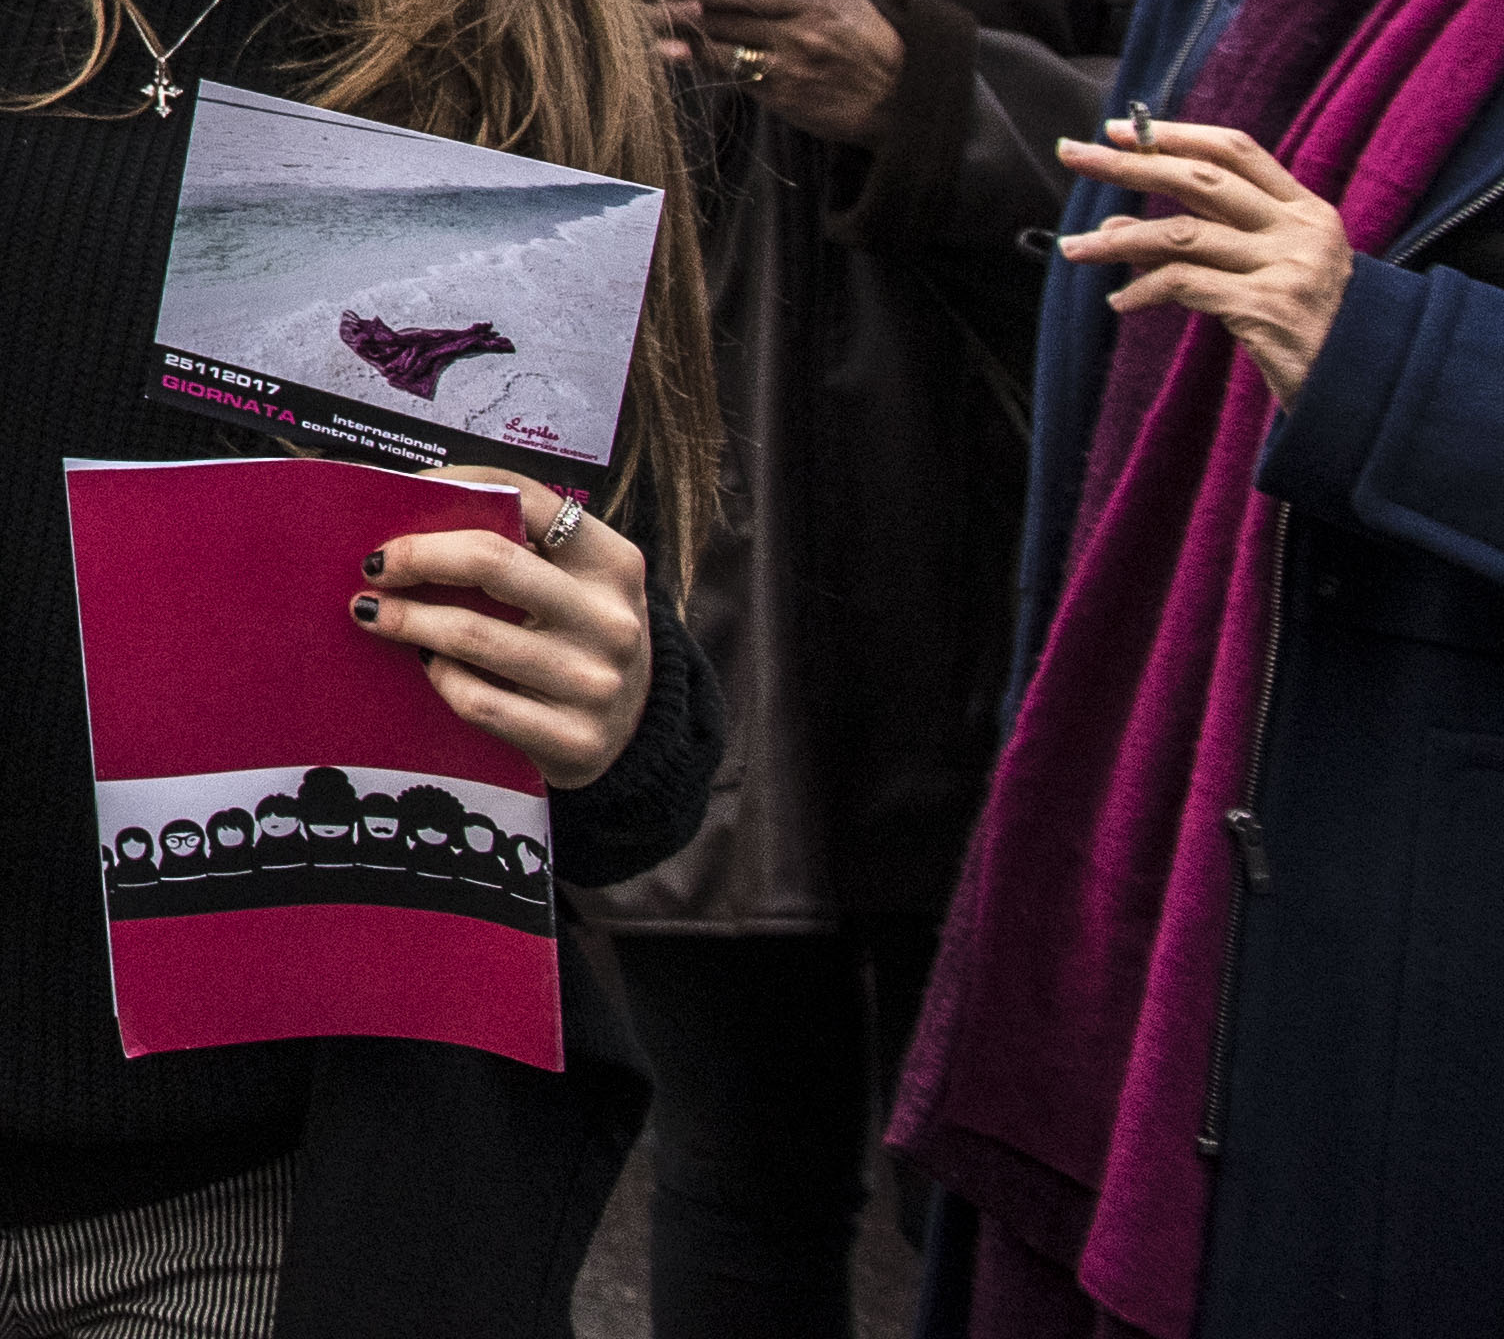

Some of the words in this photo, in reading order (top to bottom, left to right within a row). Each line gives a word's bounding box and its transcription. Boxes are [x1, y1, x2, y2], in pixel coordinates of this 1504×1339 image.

[165, 352, 281, 396] 25112017
[161, 374, 296, 425] GIORNATA
[301, 420, 357, 442] contro
[360, 436, 374, 447] la
[378, 442, 443, 468] violenza
[332, 414, 447, 457] internazionale
